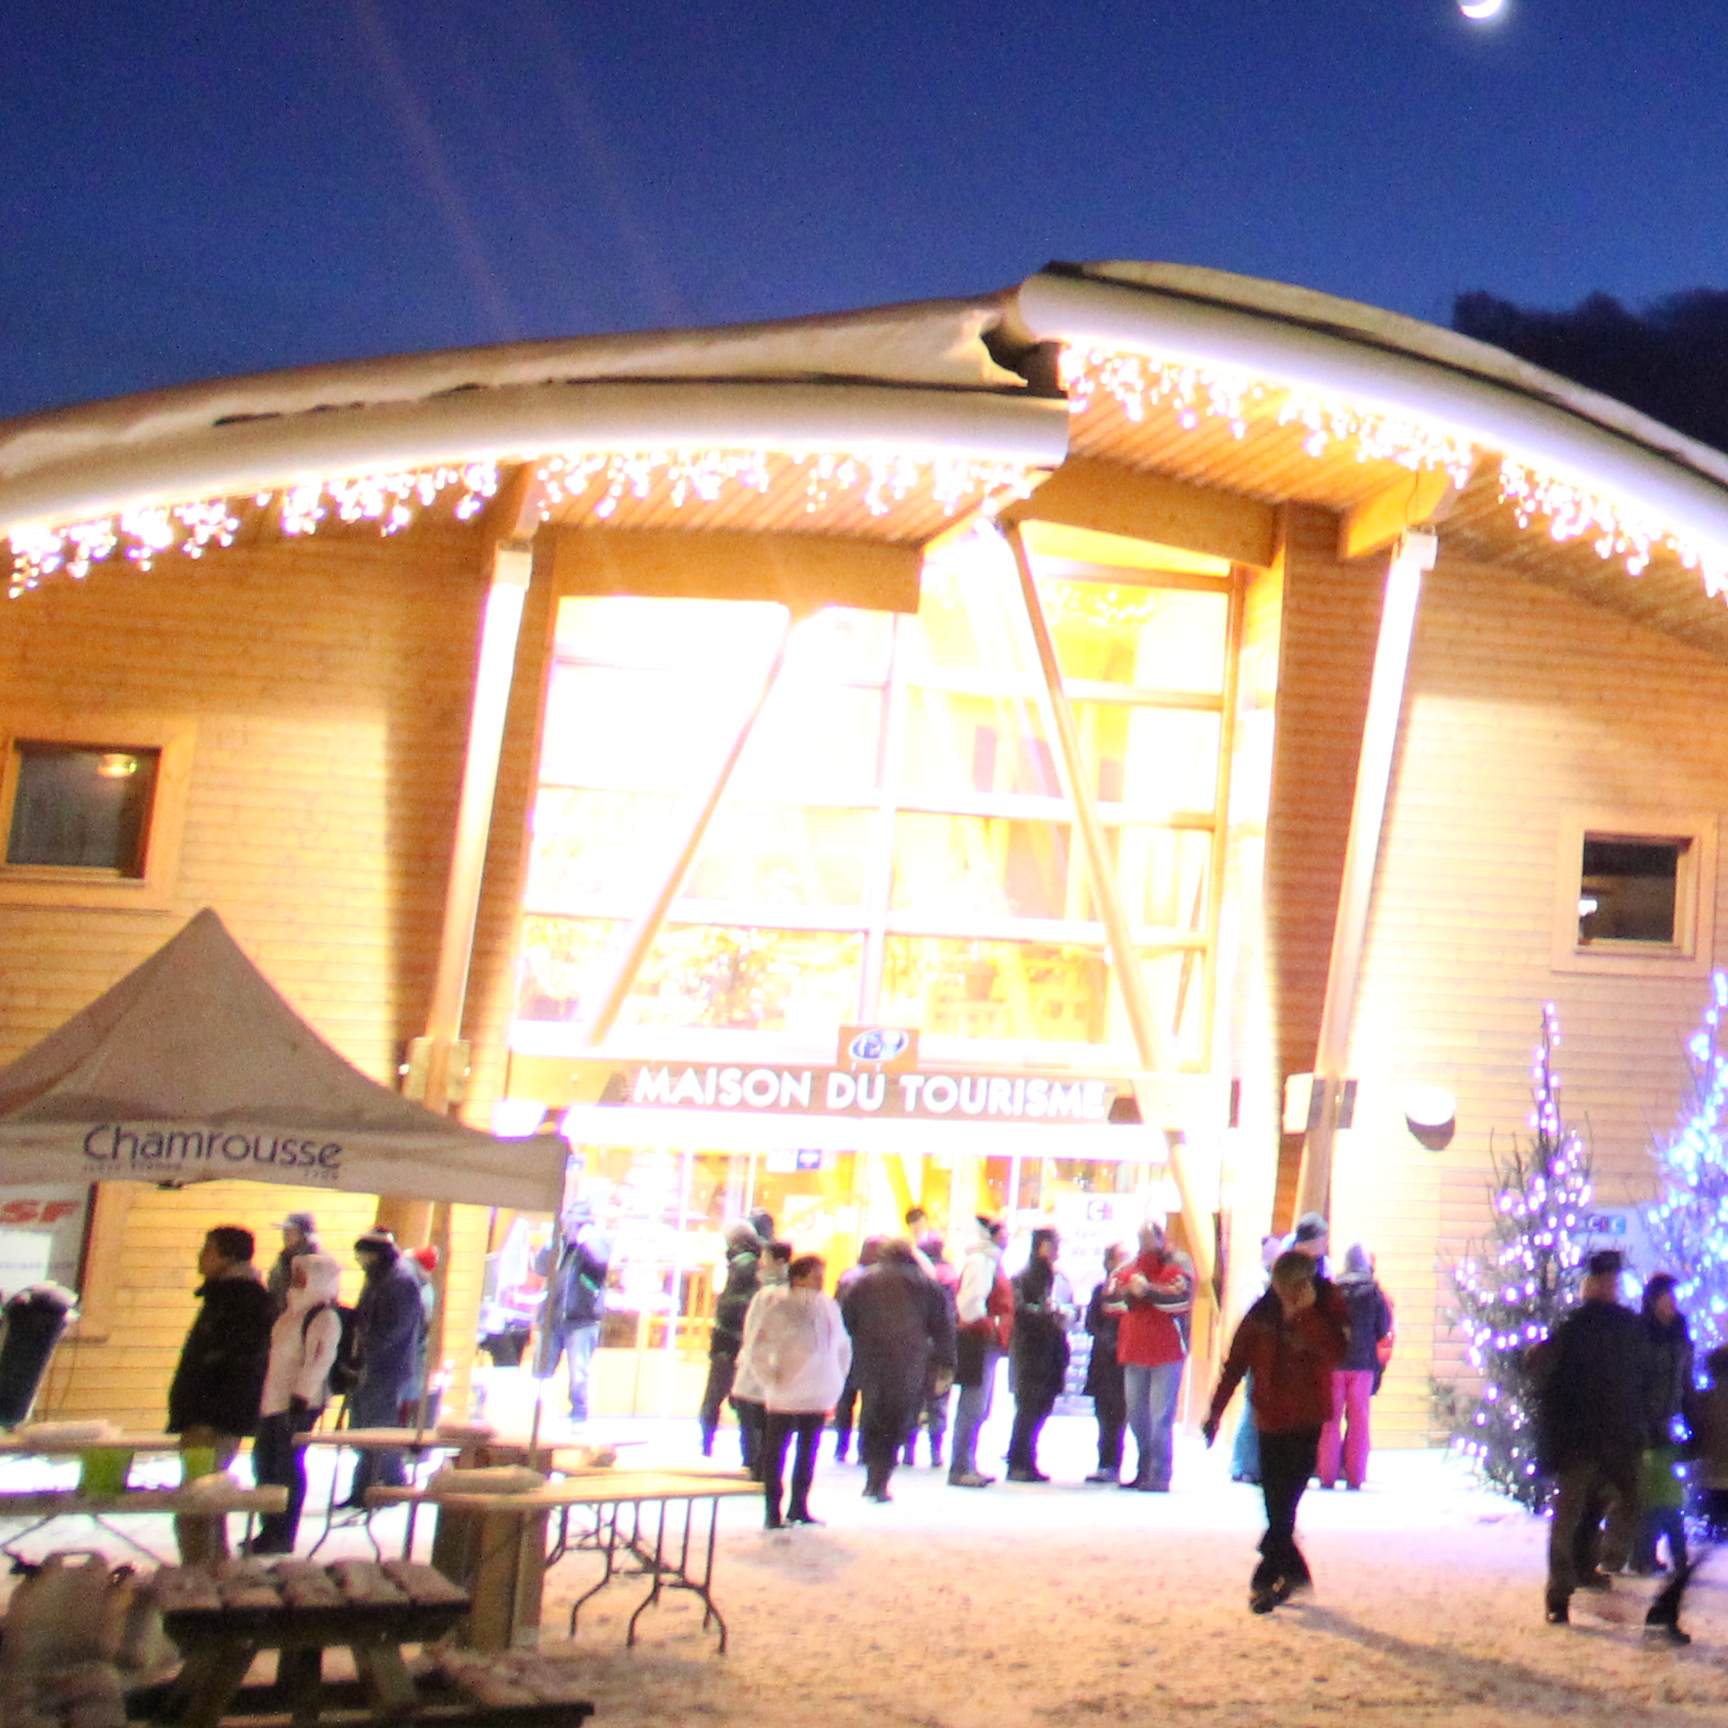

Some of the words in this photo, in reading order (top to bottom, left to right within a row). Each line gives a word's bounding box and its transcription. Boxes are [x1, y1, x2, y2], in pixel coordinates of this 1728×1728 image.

[633, 1065, 813, 1108] MAISON
[826, 1071, 887, 1112] DU
[899, 1074, 1107, 1119] TOURISME
[83, 1122, 343, 1170] Chamrousse
